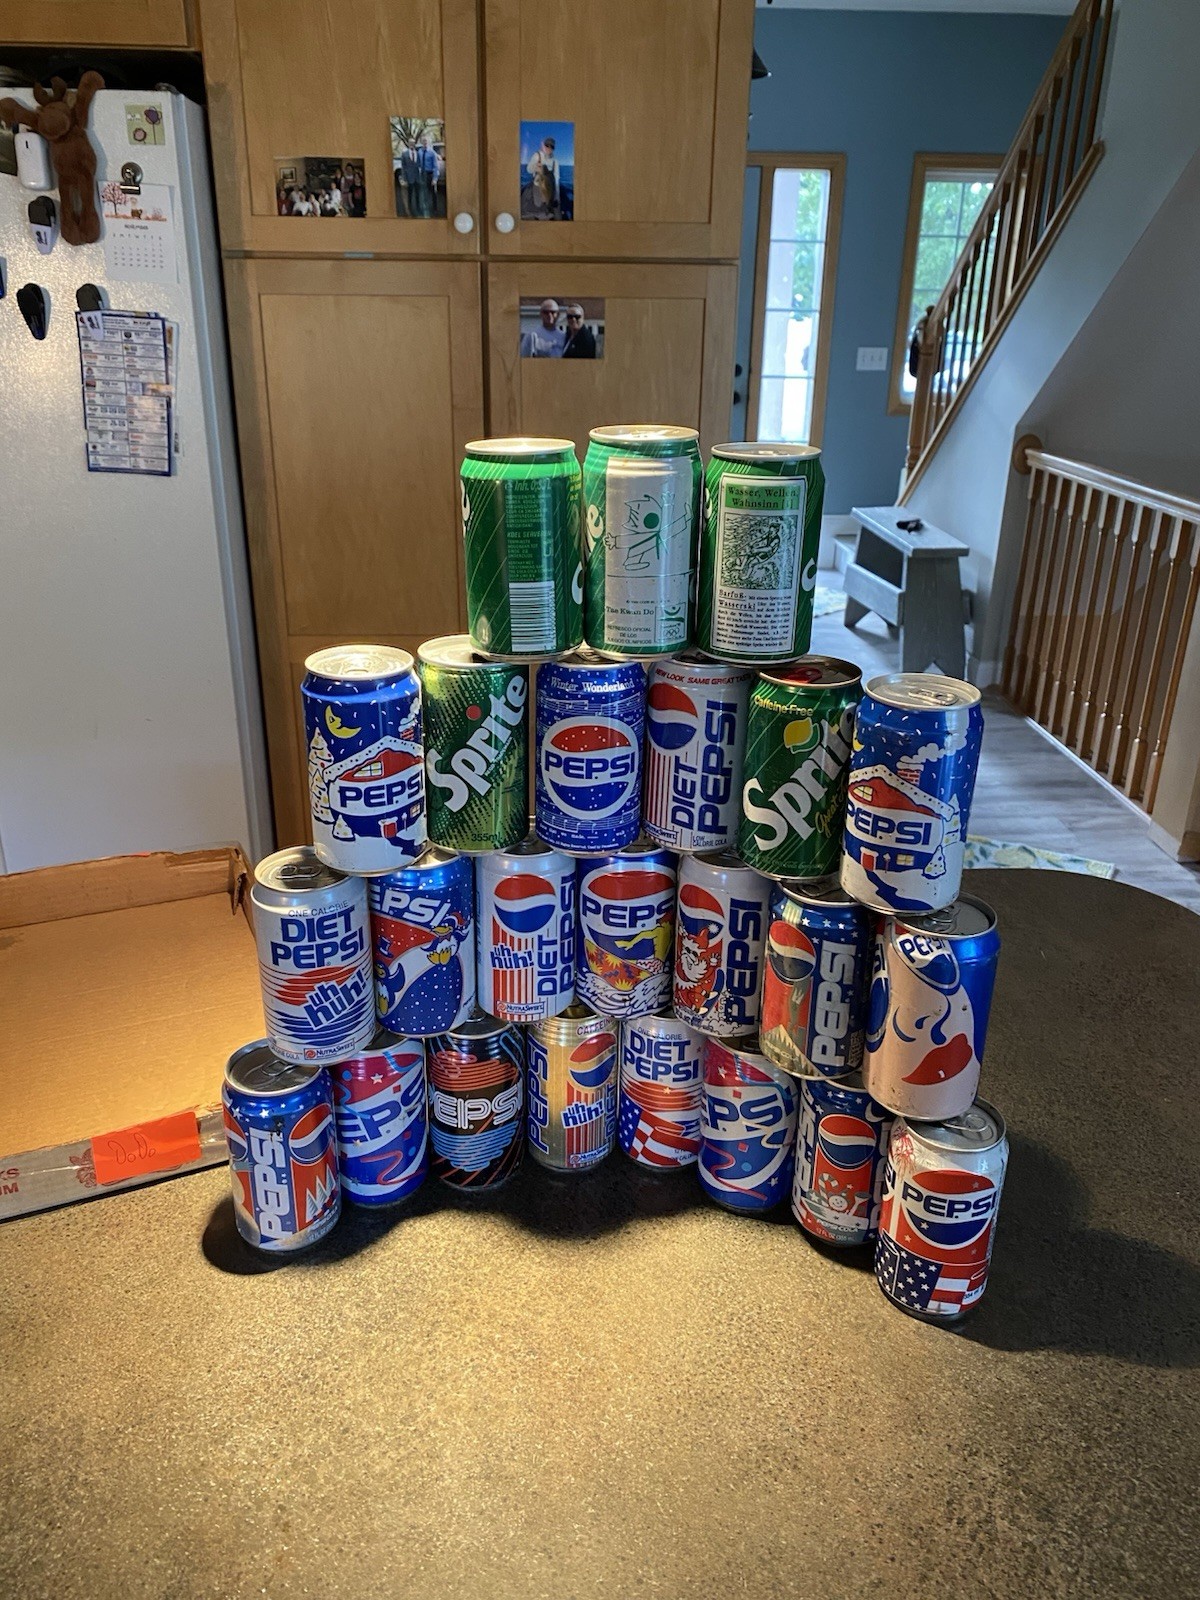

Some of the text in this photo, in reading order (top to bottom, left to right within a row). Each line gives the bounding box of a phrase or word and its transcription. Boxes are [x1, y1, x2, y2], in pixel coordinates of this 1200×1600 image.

[728, 486, 761, 497] Wasser,
[732, 498, 779, 509] Wahnsinn
[551, 677, 635, 692] Winter Wonderland
[667, 674, 684, 682] LOOK
[687, 676, 710, 684] SAME
[426, 674, 528, 813] Sprite
[545, 750, 635, 779] PEPSI
[697, 700, 738, 835] PEPSI
[338, 769, 423, 808] PEPSI
[671, 755, 697, 830] DIET
[281, 905, 355, 942] DIET
[288, 900, 349, 917] ONE CALORIE
[369, 883, 451, 927] EPSI
[582, 893, 674, 928] PEPS
[271, 926, 364, 968] PEPSI
[538, 935, 557, 995] DIET
[726, 898, 762, 1026] PEPSI
[811, 940, 857, 1067] PEPSI
[577, 1016, 614, 1036] CAFFEIN
[624, 1046, 699, 1082] PEPSI
[630, 1030, 691, 1061] DIET
[335, 1067, 424, 1144] EPS
[527, 1033, 549, 1154] PEPSI
[250, 1127, 293, 1239] PEPSI
[902, 1181, 997, 1218] PEPSI
